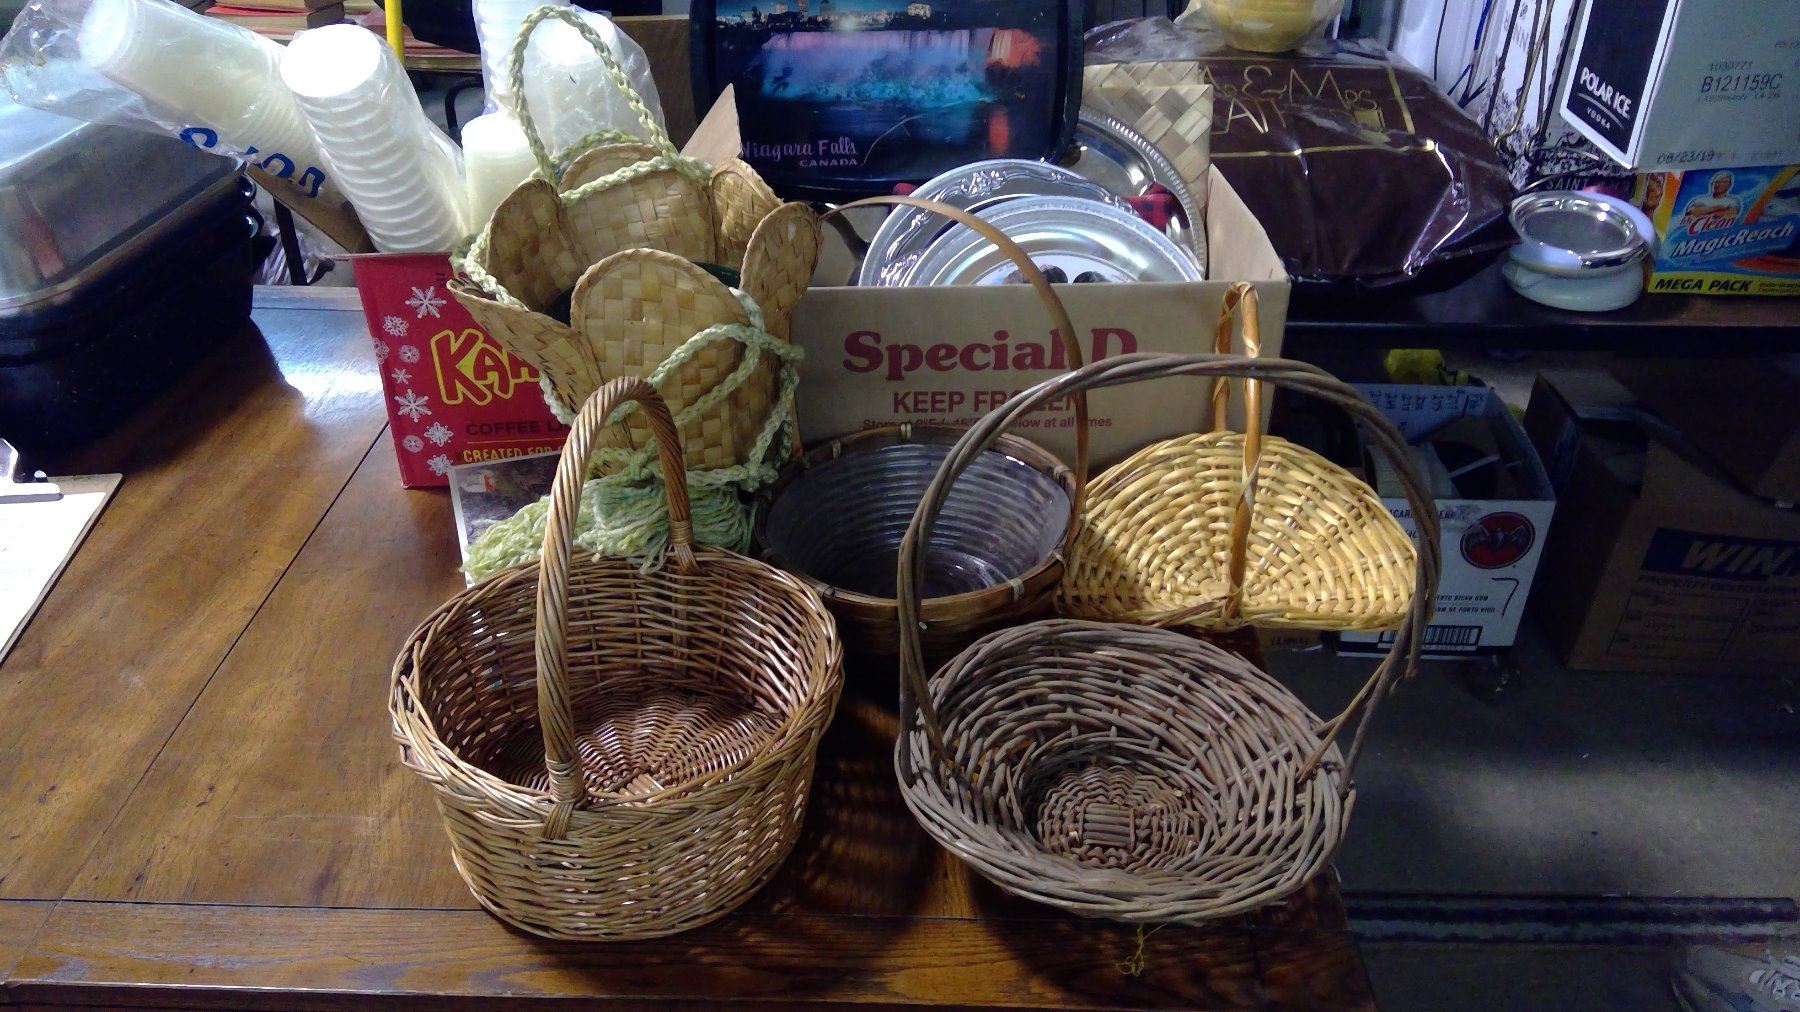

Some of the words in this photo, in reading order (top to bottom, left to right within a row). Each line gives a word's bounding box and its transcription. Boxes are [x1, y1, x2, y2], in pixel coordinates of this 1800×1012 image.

[1240, 65, 1287, 100] &
[1579, 67, 1613, 105] POLAR
[1612, 87, 1632, 118] ICE
[1701, 73, 1783, 93] B121159C
[1587, 106, 1611, 131] VODKA
[740, 141, 814, 162] Niagara
[818, 136, 859, 156] Falls
[1656, 150, 1715, 164] 08/23/19
[800, 158, 858, 168] CANADA
[1688, 215, 1736, 236] Clean
[1671, 220, 1795, 258] MagicReach
[1655, 278, 1704, 290] MEGA
[1708, 279, 1754, 291] PACK
[843, 329, 1068, 381] Special
[893, 391, 965, 413] KEEP
[974, 390, 1079, 412] FREN
[466, 421, 540, 436] COFFEE
[1010, 416, 1041, 428] elow
[1044, 416, 1057, 428] at
[1059, 416, 1074, 428] all
[1088, 417, 1113, 427] mes
[462, 446, 522, 464] CREATED
[1491, 577, 1519, 618] 7
